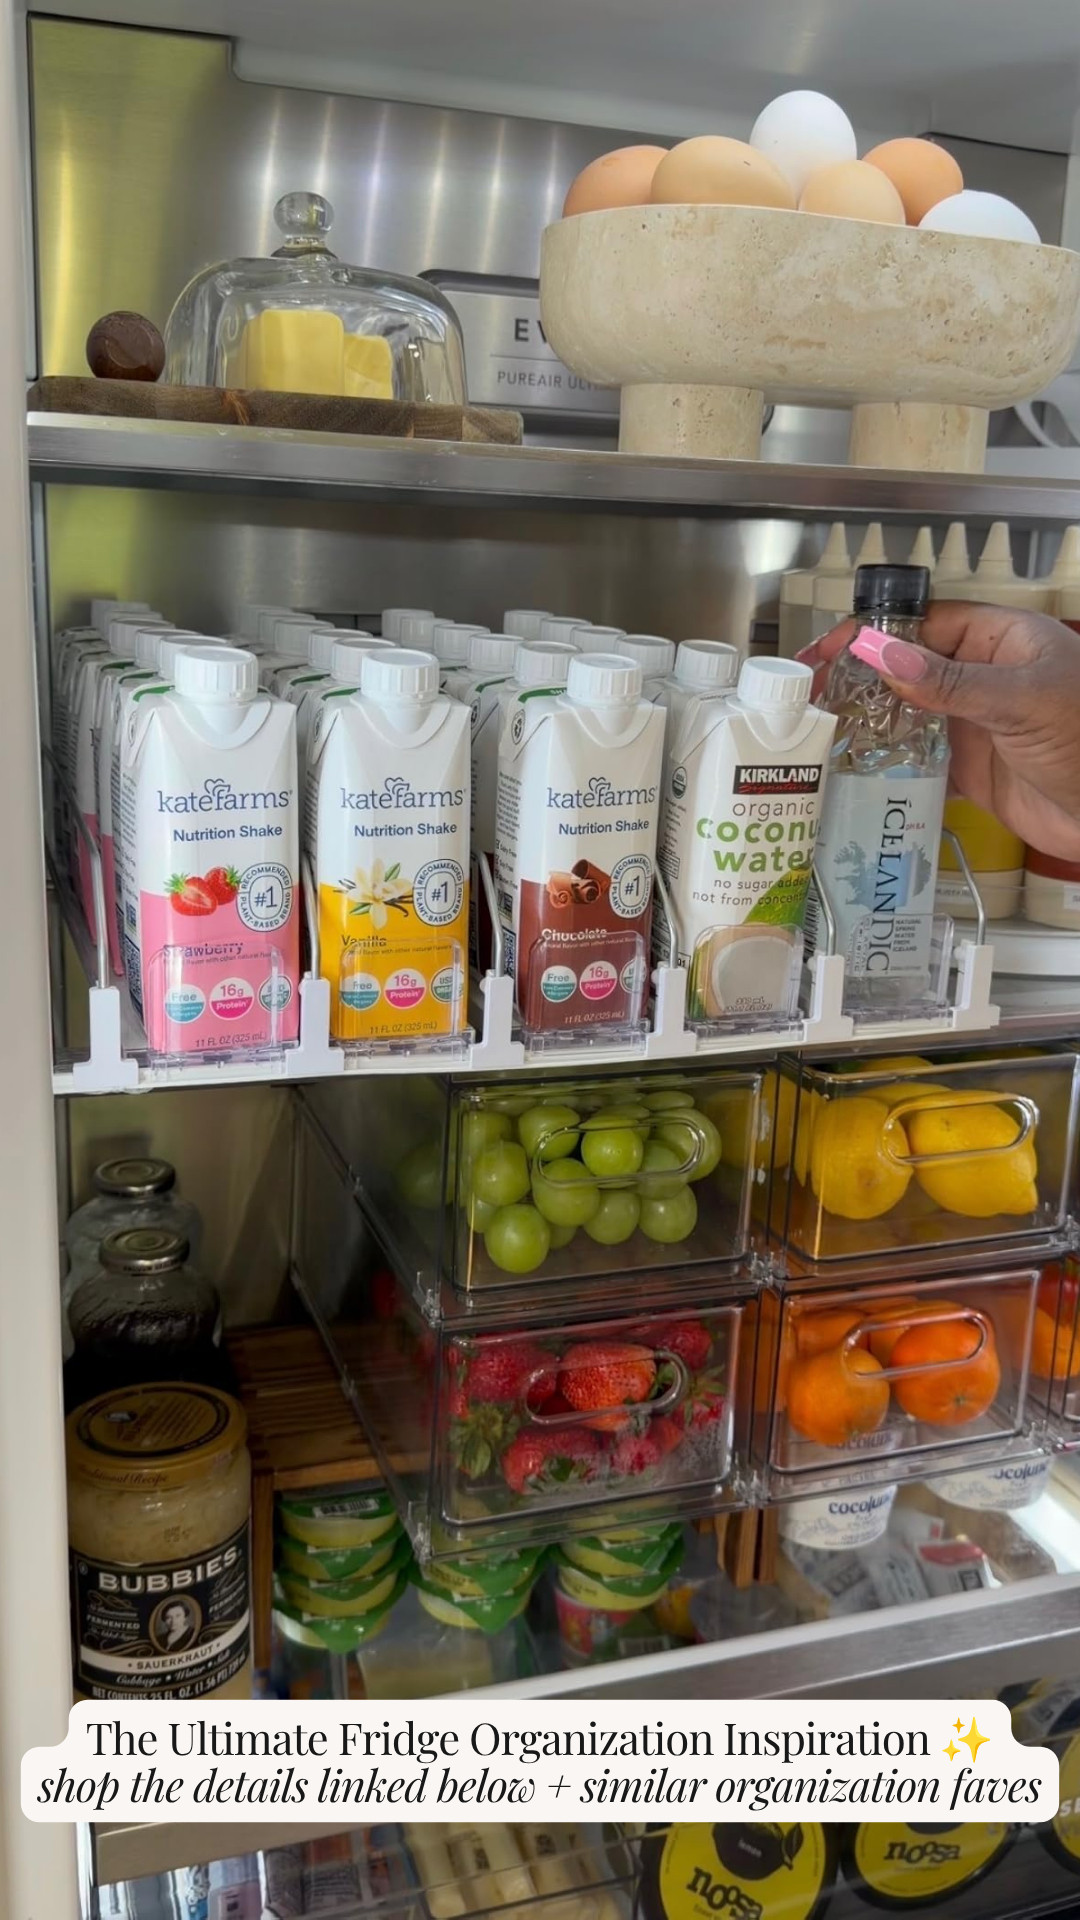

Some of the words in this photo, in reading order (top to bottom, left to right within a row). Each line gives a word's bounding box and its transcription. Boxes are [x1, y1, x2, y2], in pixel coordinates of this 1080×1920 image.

[497, 370, 562, 389] PUREAIR
[739, 767, 820, 784] KIRKLAND
[157, 783, 292, 814] katefarms
[340, 781, 465, 811] katefarms
[546, 783, 657, 810] katefarms
[732, 797, 815, 822] organic
[172, 827, 236, 843] Nutrition
[239, 824, 283, 839] Shake
[353, 823, 414, 838] Nutrition
[416, 822, 458, 835] Shake
[557, 822, 613, 836] Nutrition
[614, 819, 650, 834] Shake
[696, 818, 819, 844] coconu
[241, 866, 291, 890] RECOMMENDED
[417, 862, 463, 886] RECOMMENDED
[431, 881, 449, 903] #1
[624, 875, 640, 897] #1
[714, 879, 732, 889] no
[737, 879, 774, 893] sugar
[254, 885, 278, 908] #1
[692, 891, 716, 903] not
[721, 893, 753, 906] from
[240, 896, 280, 928] PLANT-BASED
[416, 891, 453, 923] PLANT-BASED
[394, 974, 418, 988] 16g
[547, 973, 570, 983] Free
[589, 966, 610, 980] 16g
[171, 991, 198, 1002] Free
[220, 984, 245, 998] 16g
[404, 1022, 423, 1033] (325
[231, 1035, 251, 1045] (325
[98, 1545, 239, 1594] BUBBIES
[86, 1613, 141, 1631] FERMENTED
[136, 1644, 215, 1671] SAUERKRAUT
[883, 1841, 961, 1864] noosa
